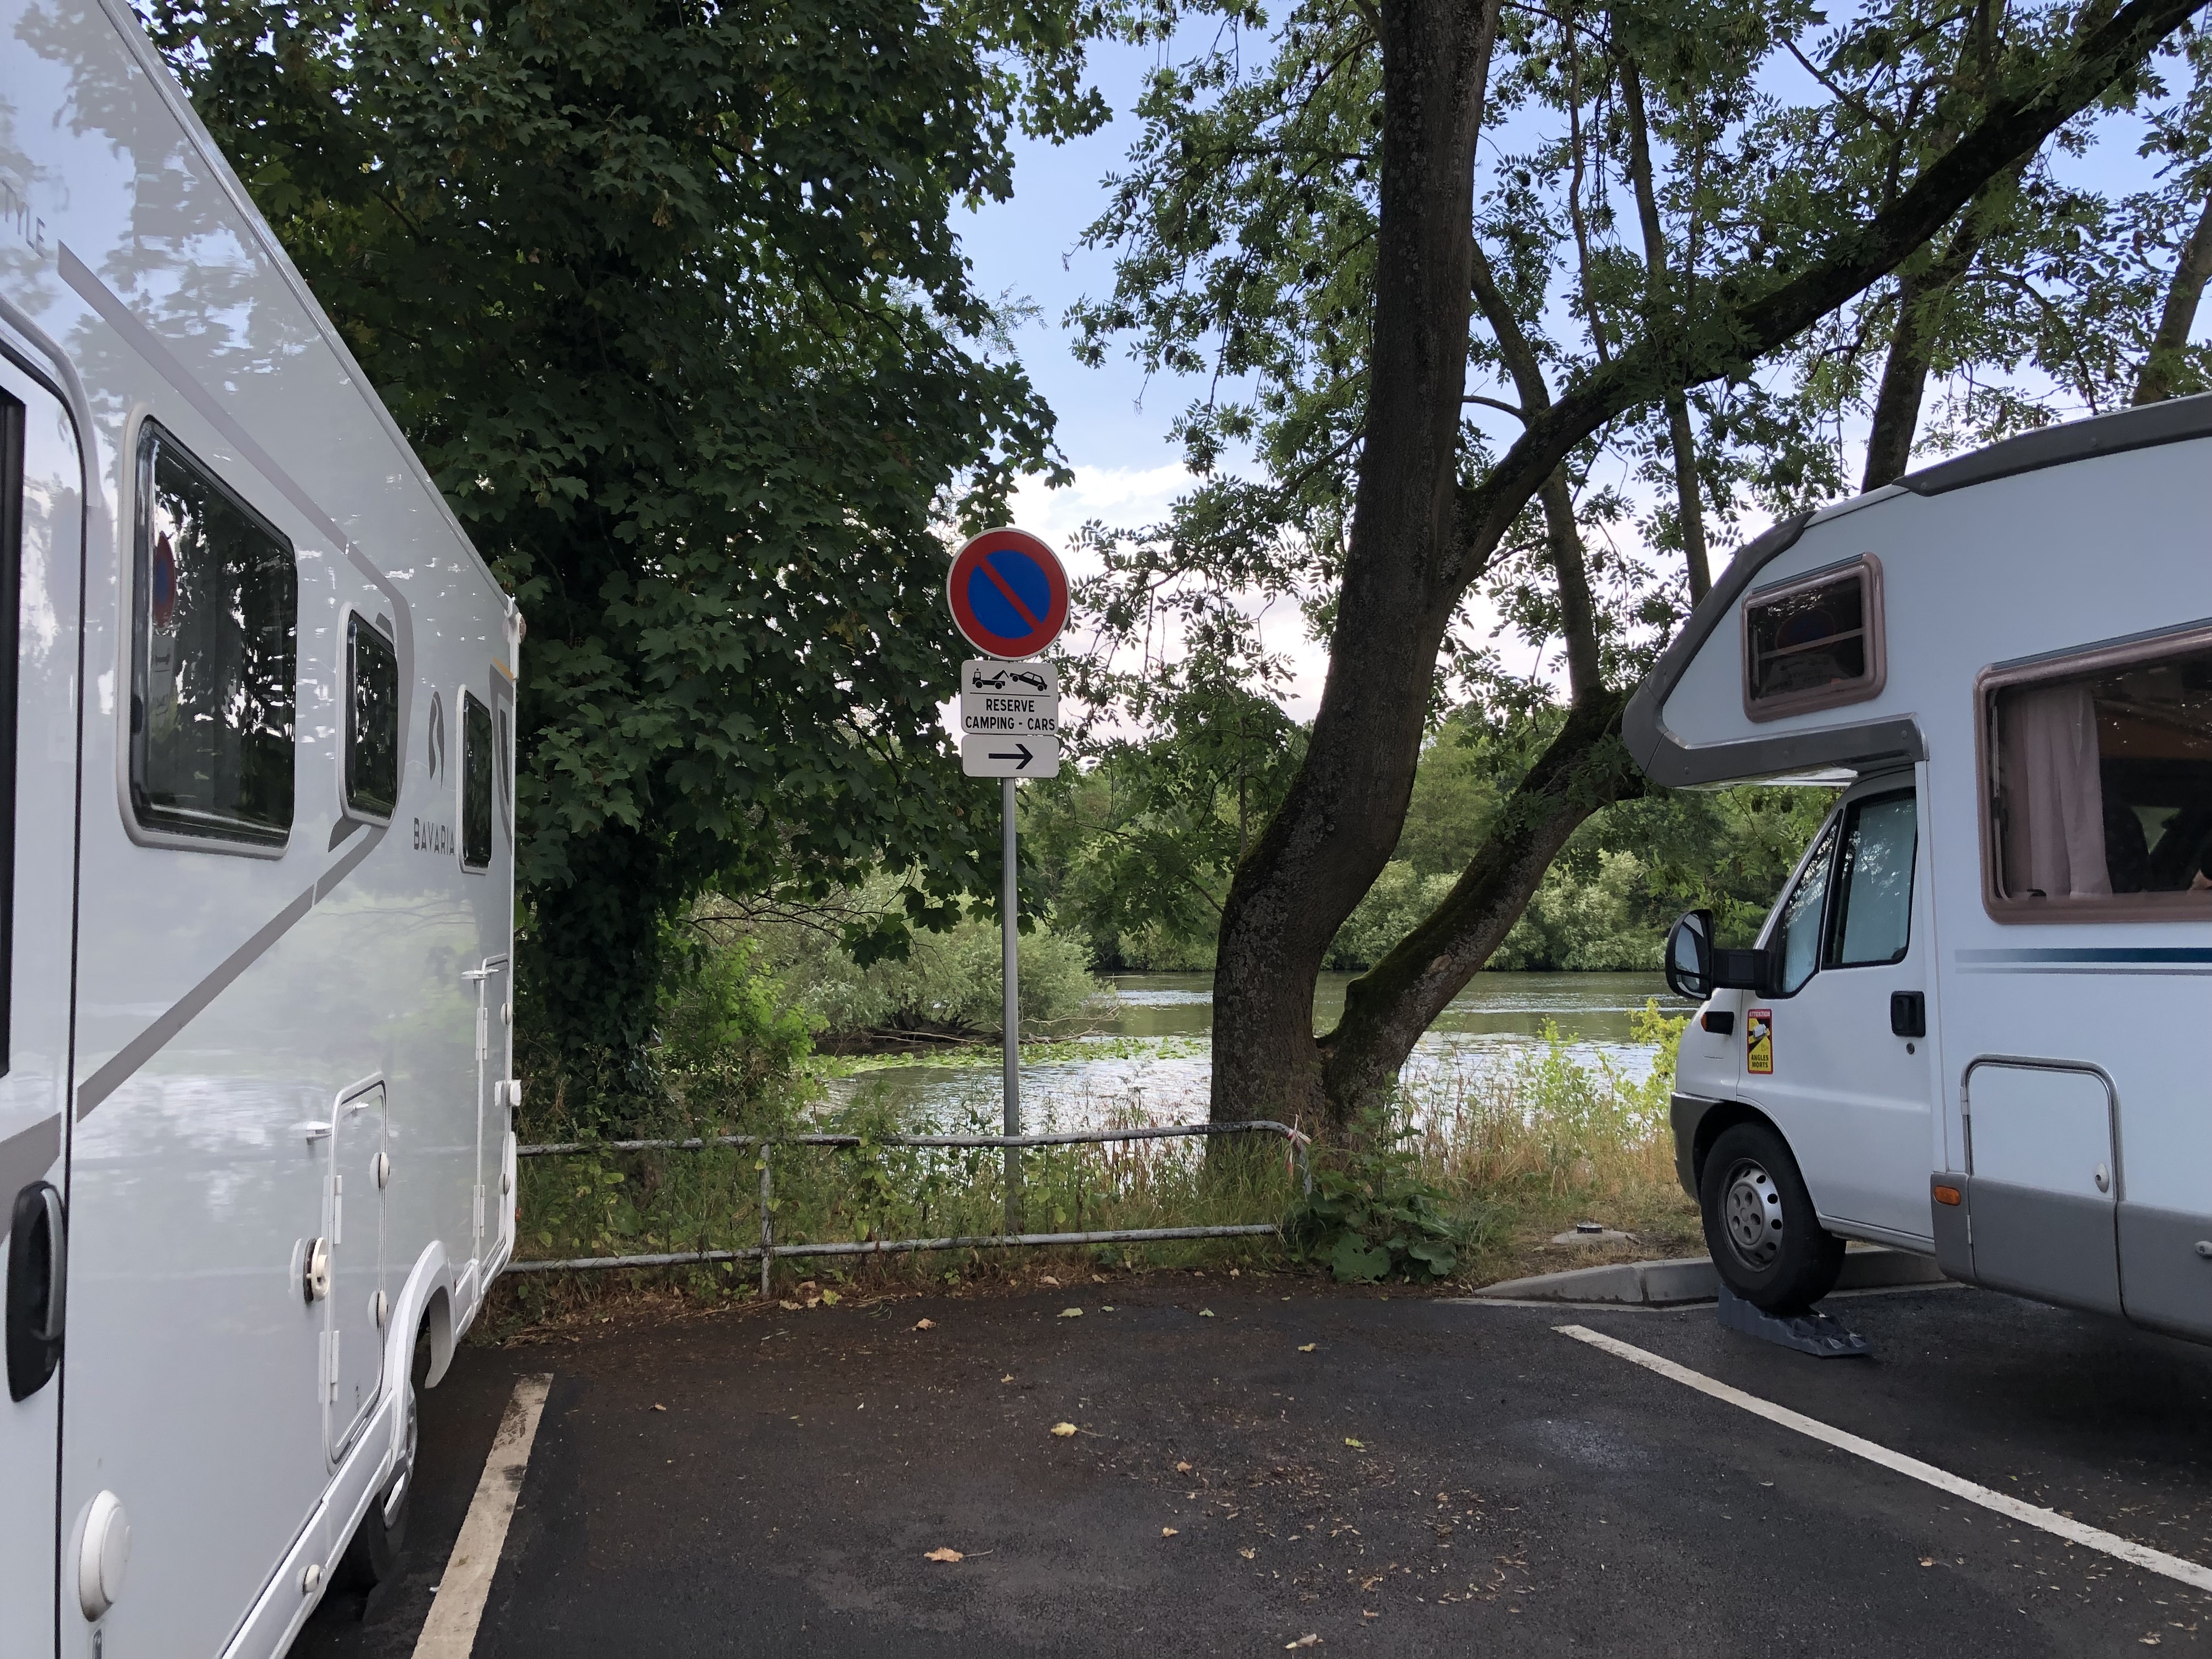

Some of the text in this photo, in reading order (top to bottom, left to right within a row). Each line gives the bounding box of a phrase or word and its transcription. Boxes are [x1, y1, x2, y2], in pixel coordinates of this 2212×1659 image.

[986, 698, 1035, 713] RESERVE
[965, 716, 1014, 730] CAMPING
[1027, 717, 1055, 731] CARS
[414, 817, 455, 856] BAVARIA
